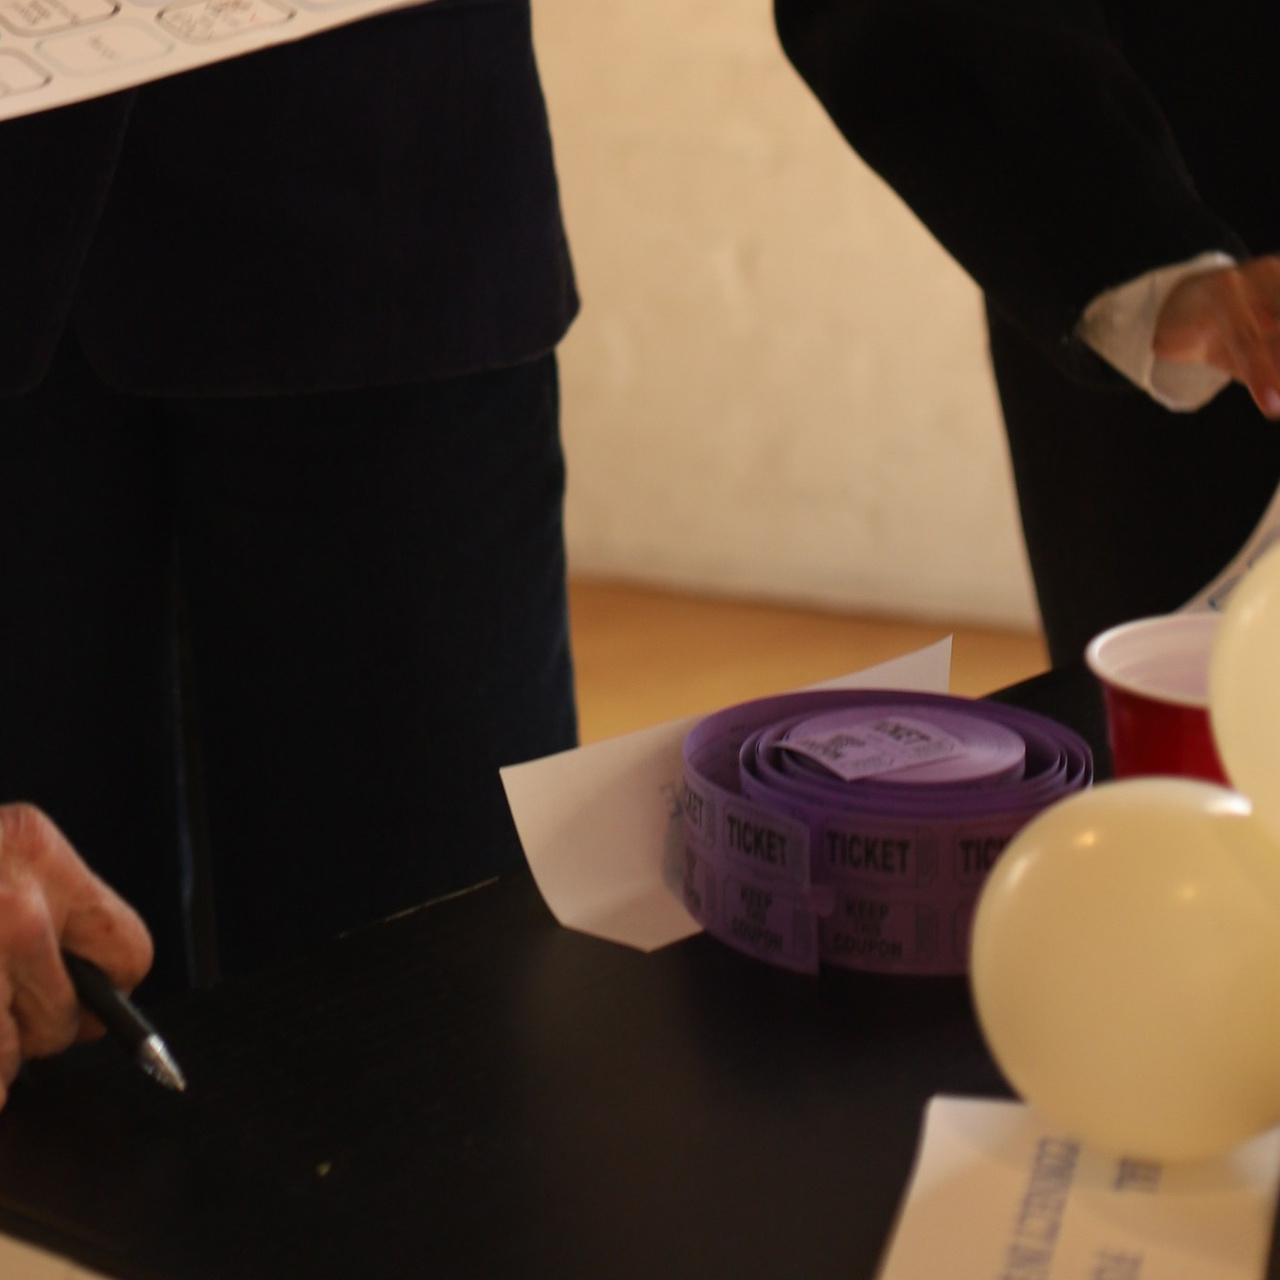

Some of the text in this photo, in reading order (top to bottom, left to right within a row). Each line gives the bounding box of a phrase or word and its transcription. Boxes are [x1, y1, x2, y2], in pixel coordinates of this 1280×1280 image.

[727, 813, 787, 868] TICKET
[826, 828, 912, 874] TICKET
[958, 836, 1009, 875] TIC
[833, 931, 903, 959] COUPON
